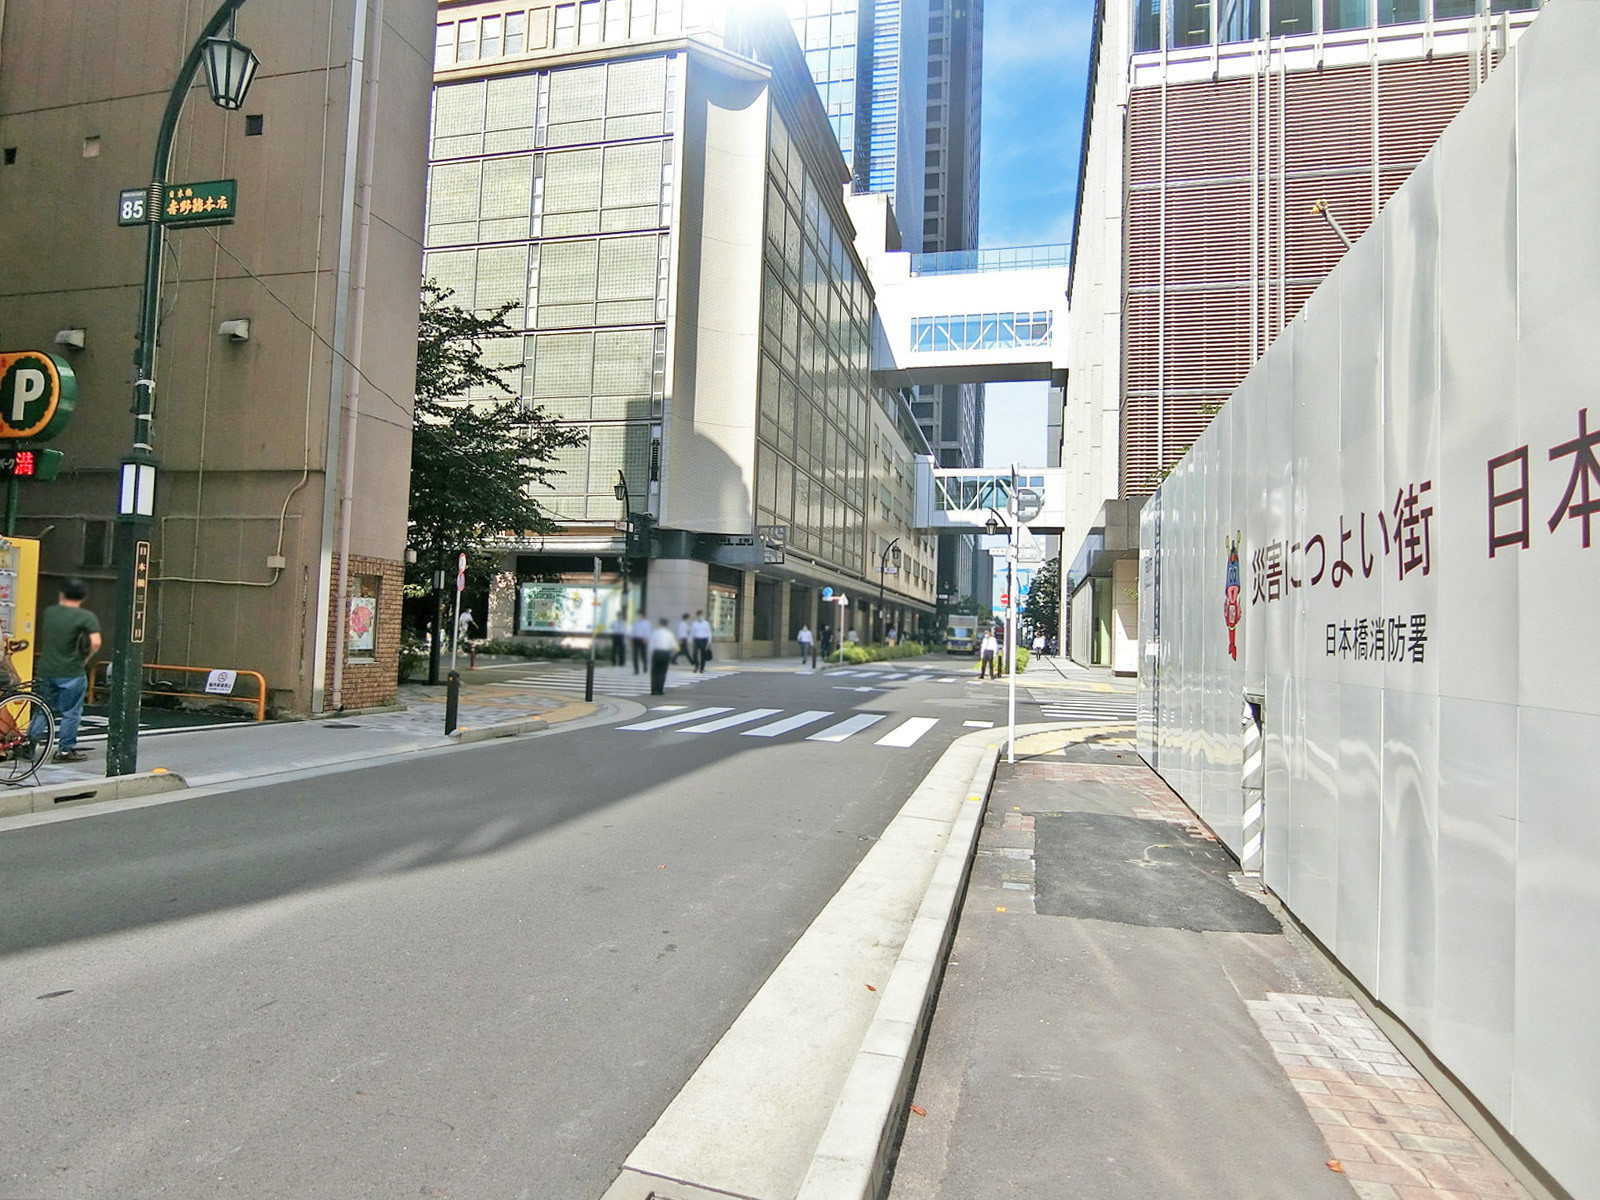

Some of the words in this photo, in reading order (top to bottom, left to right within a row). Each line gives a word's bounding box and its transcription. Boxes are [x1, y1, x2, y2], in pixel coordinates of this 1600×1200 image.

[122, 200, 144, 219] 85
[12, 368, 45, 421] P
[15, 451, 34, 475] 満
[1487, 407, 1600, 559] 日本
[1252, 480, 1433, 606] 災害につよい街
[1326, 614, 1428, 663] 日本橋消防署
